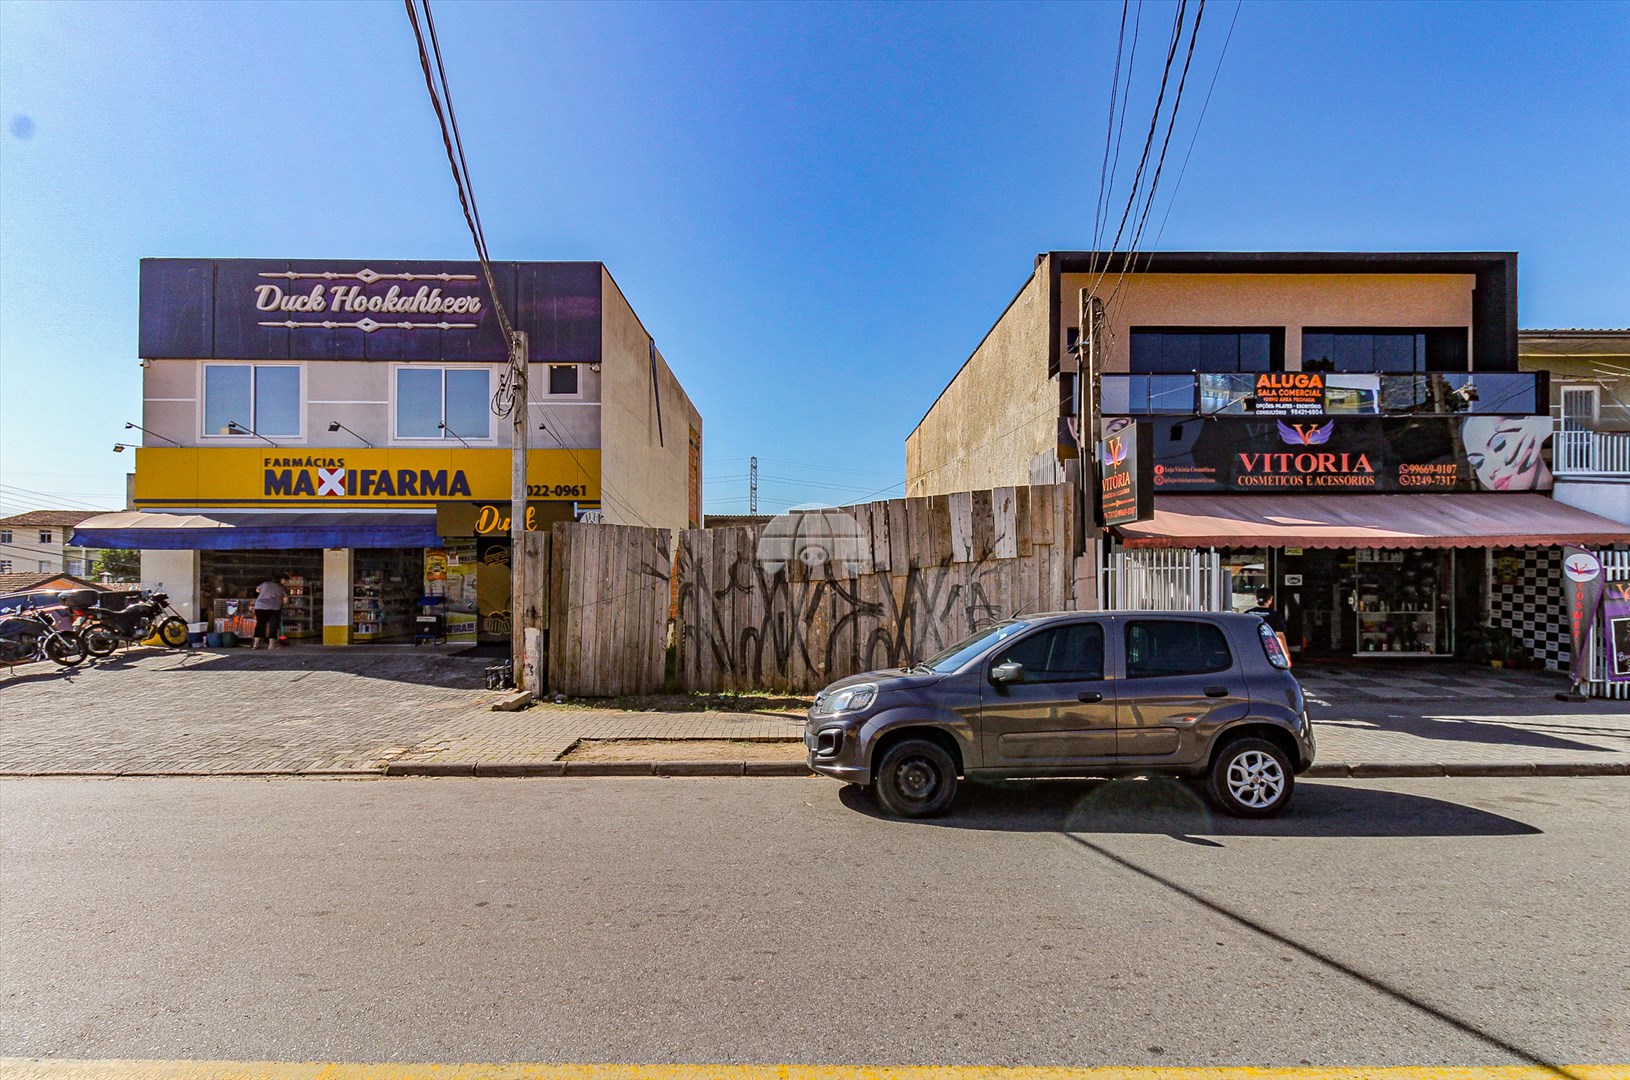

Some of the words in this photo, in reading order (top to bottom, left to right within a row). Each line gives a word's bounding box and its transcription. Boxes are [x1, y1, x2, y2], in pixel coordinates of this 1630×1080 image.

[254, 284, 326, 312] Duck
[330, 284, 482, 314] Hookahbeer
[1256, 373, 1323, 388] ALUGA
[1257, 389, 1277, 397] SALA
[1278, 389, 1322, 397] COMERCIAL
[264, 456, 345, 467] FARMÁCIAS
[1238, 453, 1375, 473] VITORIA
[1409, 464, 1457, 474] 99669-0107
[264, 468, 472, 496] MAXIFARMA
[1306, 475, 1313, 486] E
[1314, 474, 1375, 486] ACESSÓRIOS
[1410, 476, 1457, 486] 3249-7317
[527, 485, 587, 497] 022-0961
[475, 505, 537, 534] Duk
